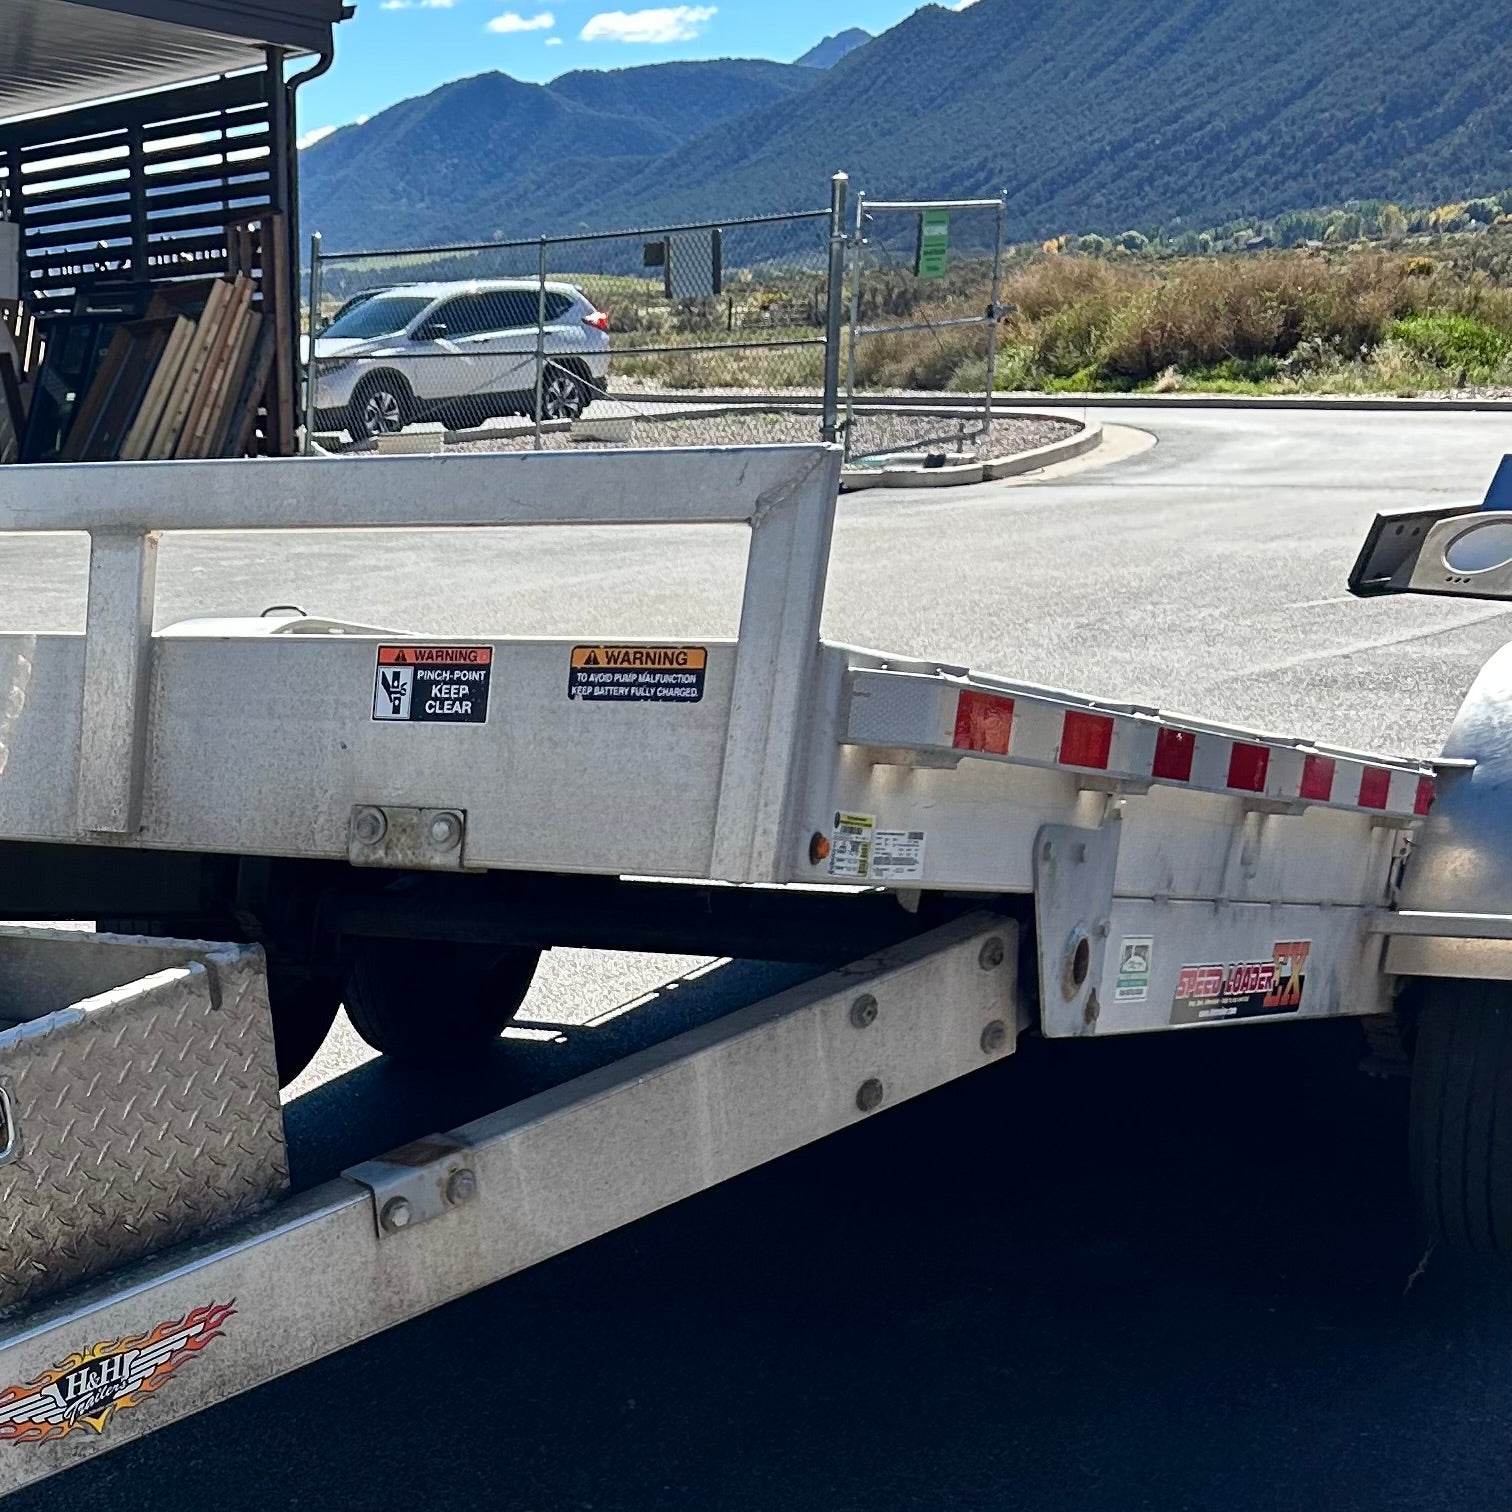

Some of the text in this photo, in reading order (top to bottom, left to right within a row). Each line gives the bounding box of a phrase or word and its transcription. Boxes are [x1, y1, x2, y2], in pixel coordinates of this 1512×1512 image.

[414, 649, 478, 662] WARNING
[604, 650, 688, 666] WARNING
[416, 669, 486, 681] PINCH-POINT
[577, 672, 696, 684] TO AVOID PUMP MALFUNCTION
[431, 684, 470, 698] KEEP
[571, 686, 592, 696] KEEP
[593, 686, 630, 696] BATTERY
[630, 686, 656, 696] FULLY
[425, 700, 473, 714] CLEAR
[1176, 965, 1224, 999] SPEED
[1224, 962, 1276, 996] LOADER
[66, 1355, 124, 1401] H&H
[64, 1379, 128, 1426] Trailers
